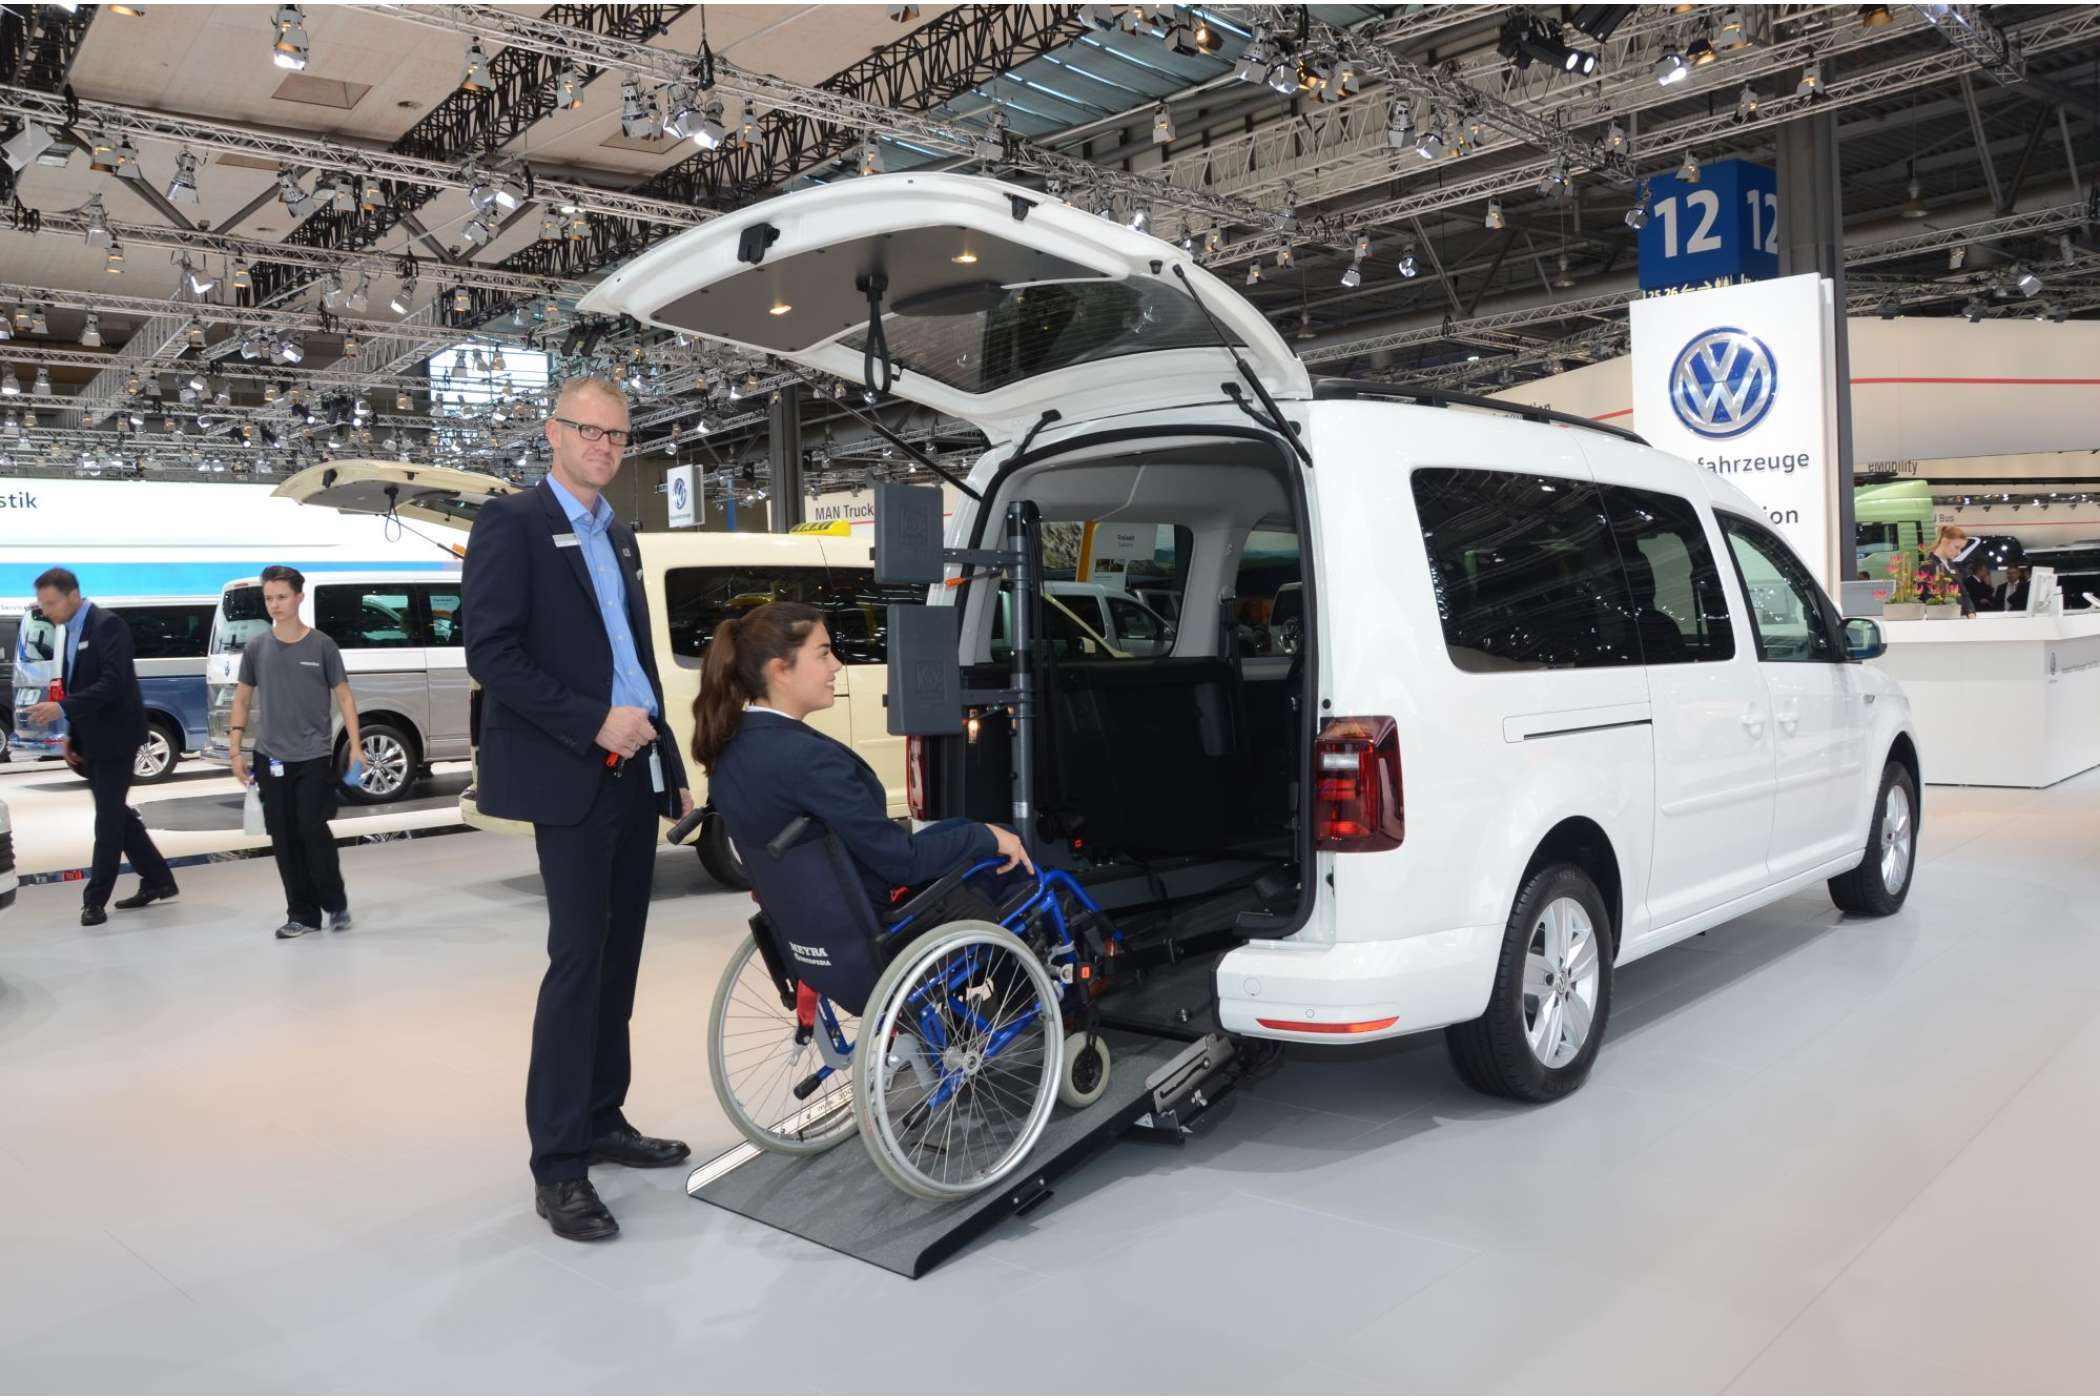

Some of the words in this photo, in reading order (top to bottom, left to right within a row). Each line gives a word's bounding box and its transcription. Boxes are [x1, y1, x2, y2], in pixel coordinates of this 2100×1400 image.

[1654, 190, 1722, 258] 12
[1746, 189, 1778, 255] 12
[815, 505, 841, 520] MAN
[843, 501, 875, 518] Truck
[1762, 505, 1799, 525] on
